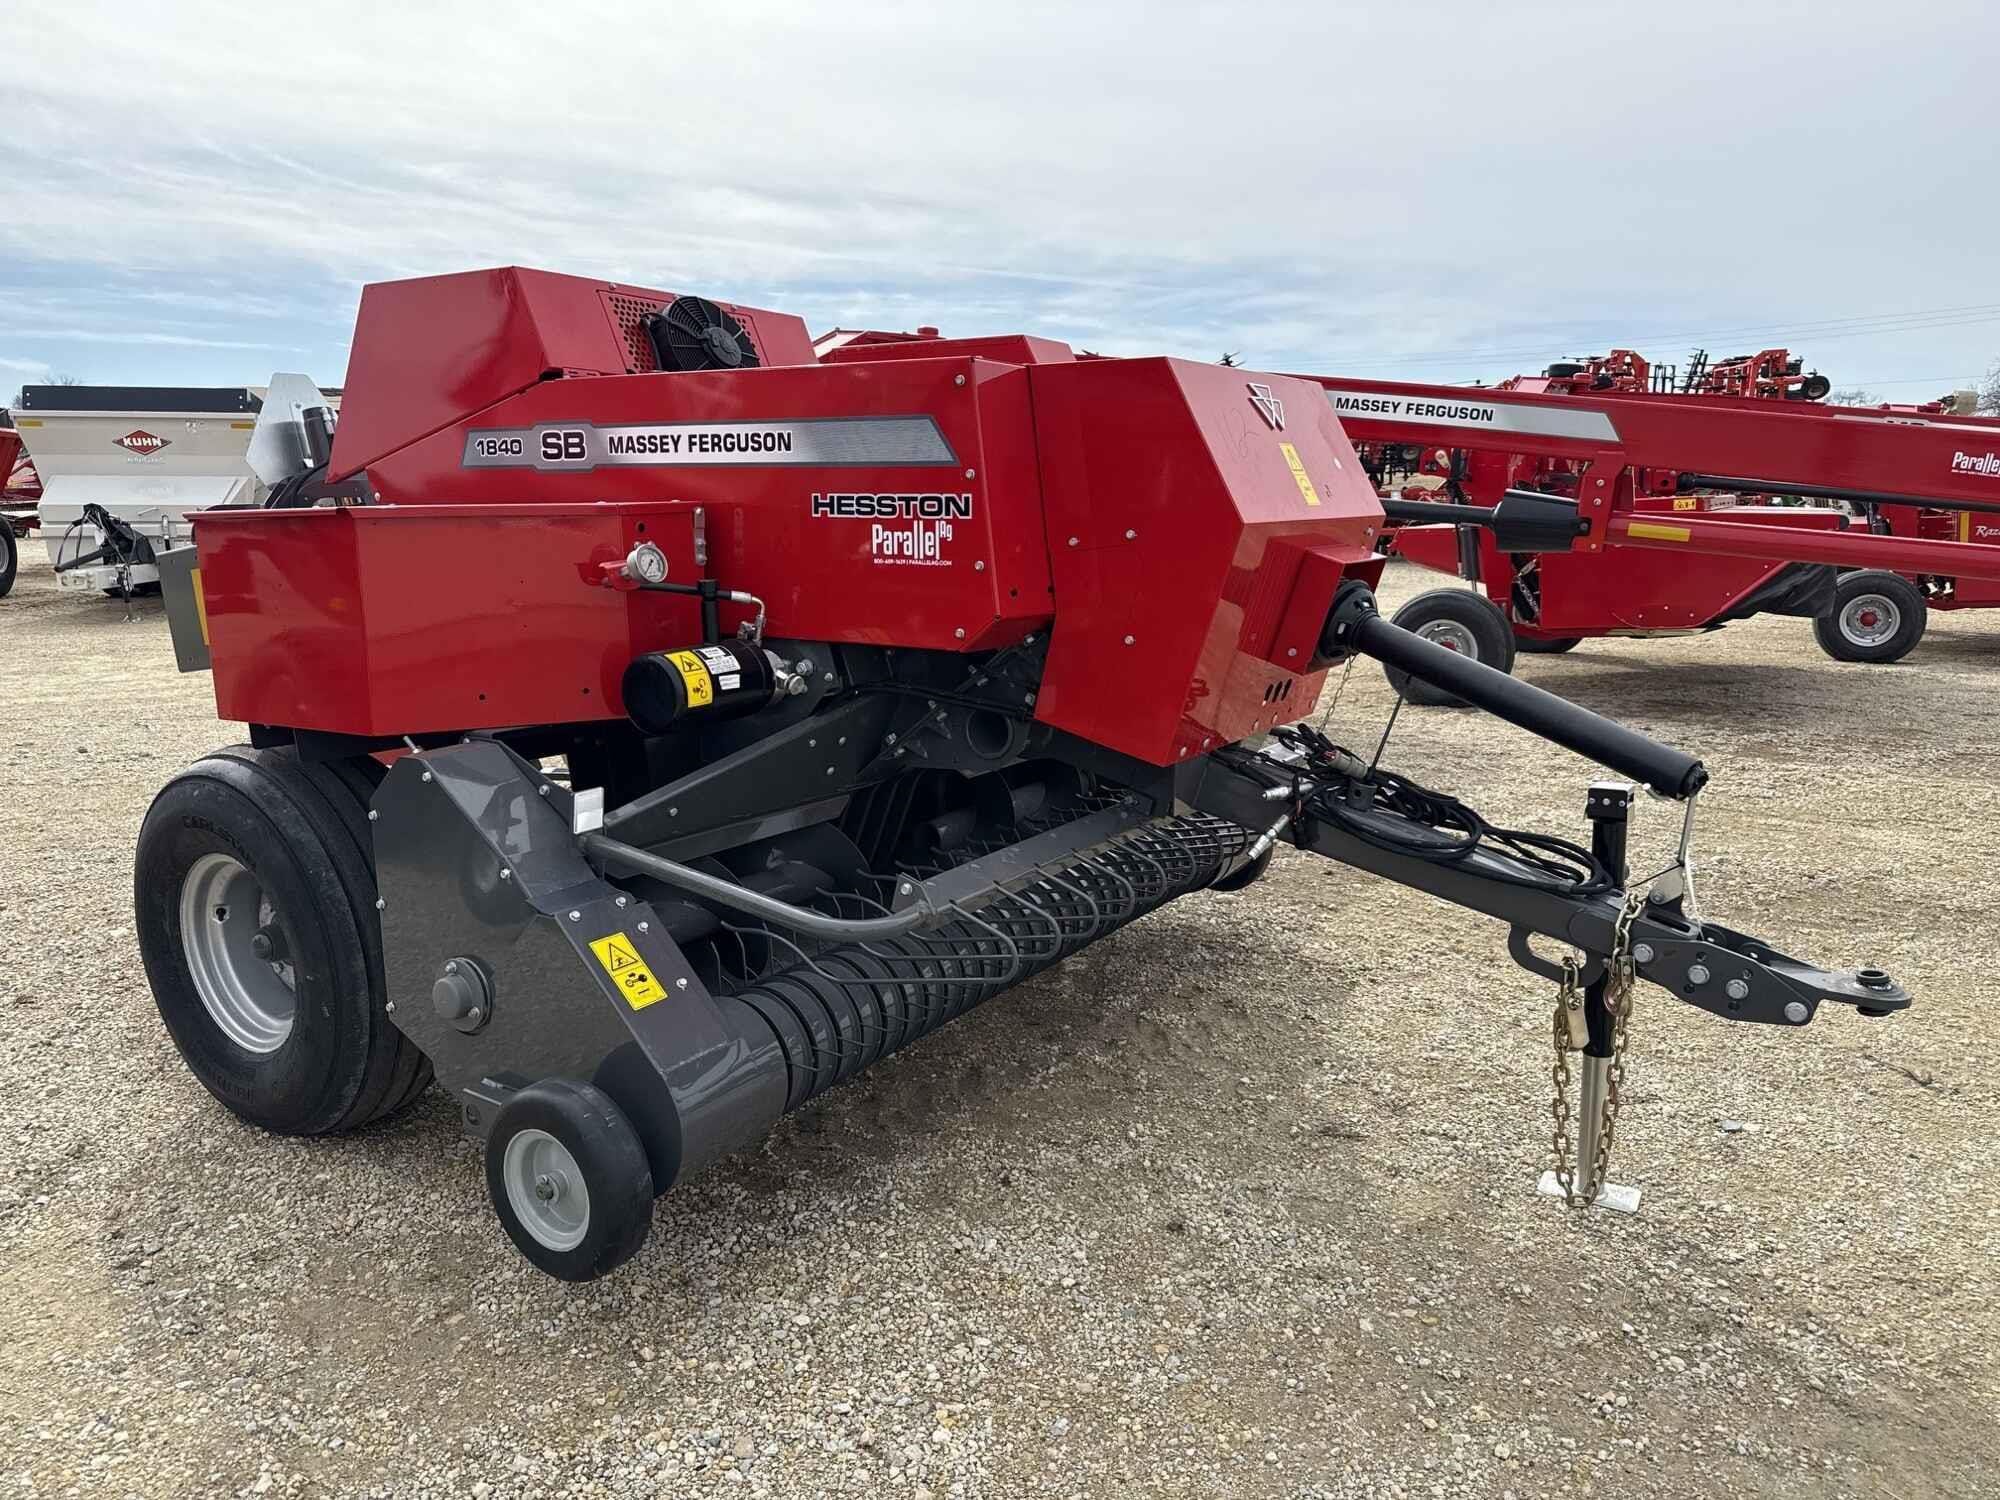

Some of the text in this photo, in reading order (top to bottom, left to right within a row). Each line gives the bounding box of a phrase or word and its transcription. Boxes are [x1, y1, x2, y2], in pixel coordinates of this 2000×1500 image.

[1335, 397, 1494, 421] MASSEY FERGUSON
[123, 437, 162, 447] KUHN
[476, 430, 792, 461] 1840 SB MASSEY FERGUSON
[1951, 451, 2000, 475] Paralle
[811, 493, 972, 519] HESSTON
[872, 520, 940, 560] Parallel
